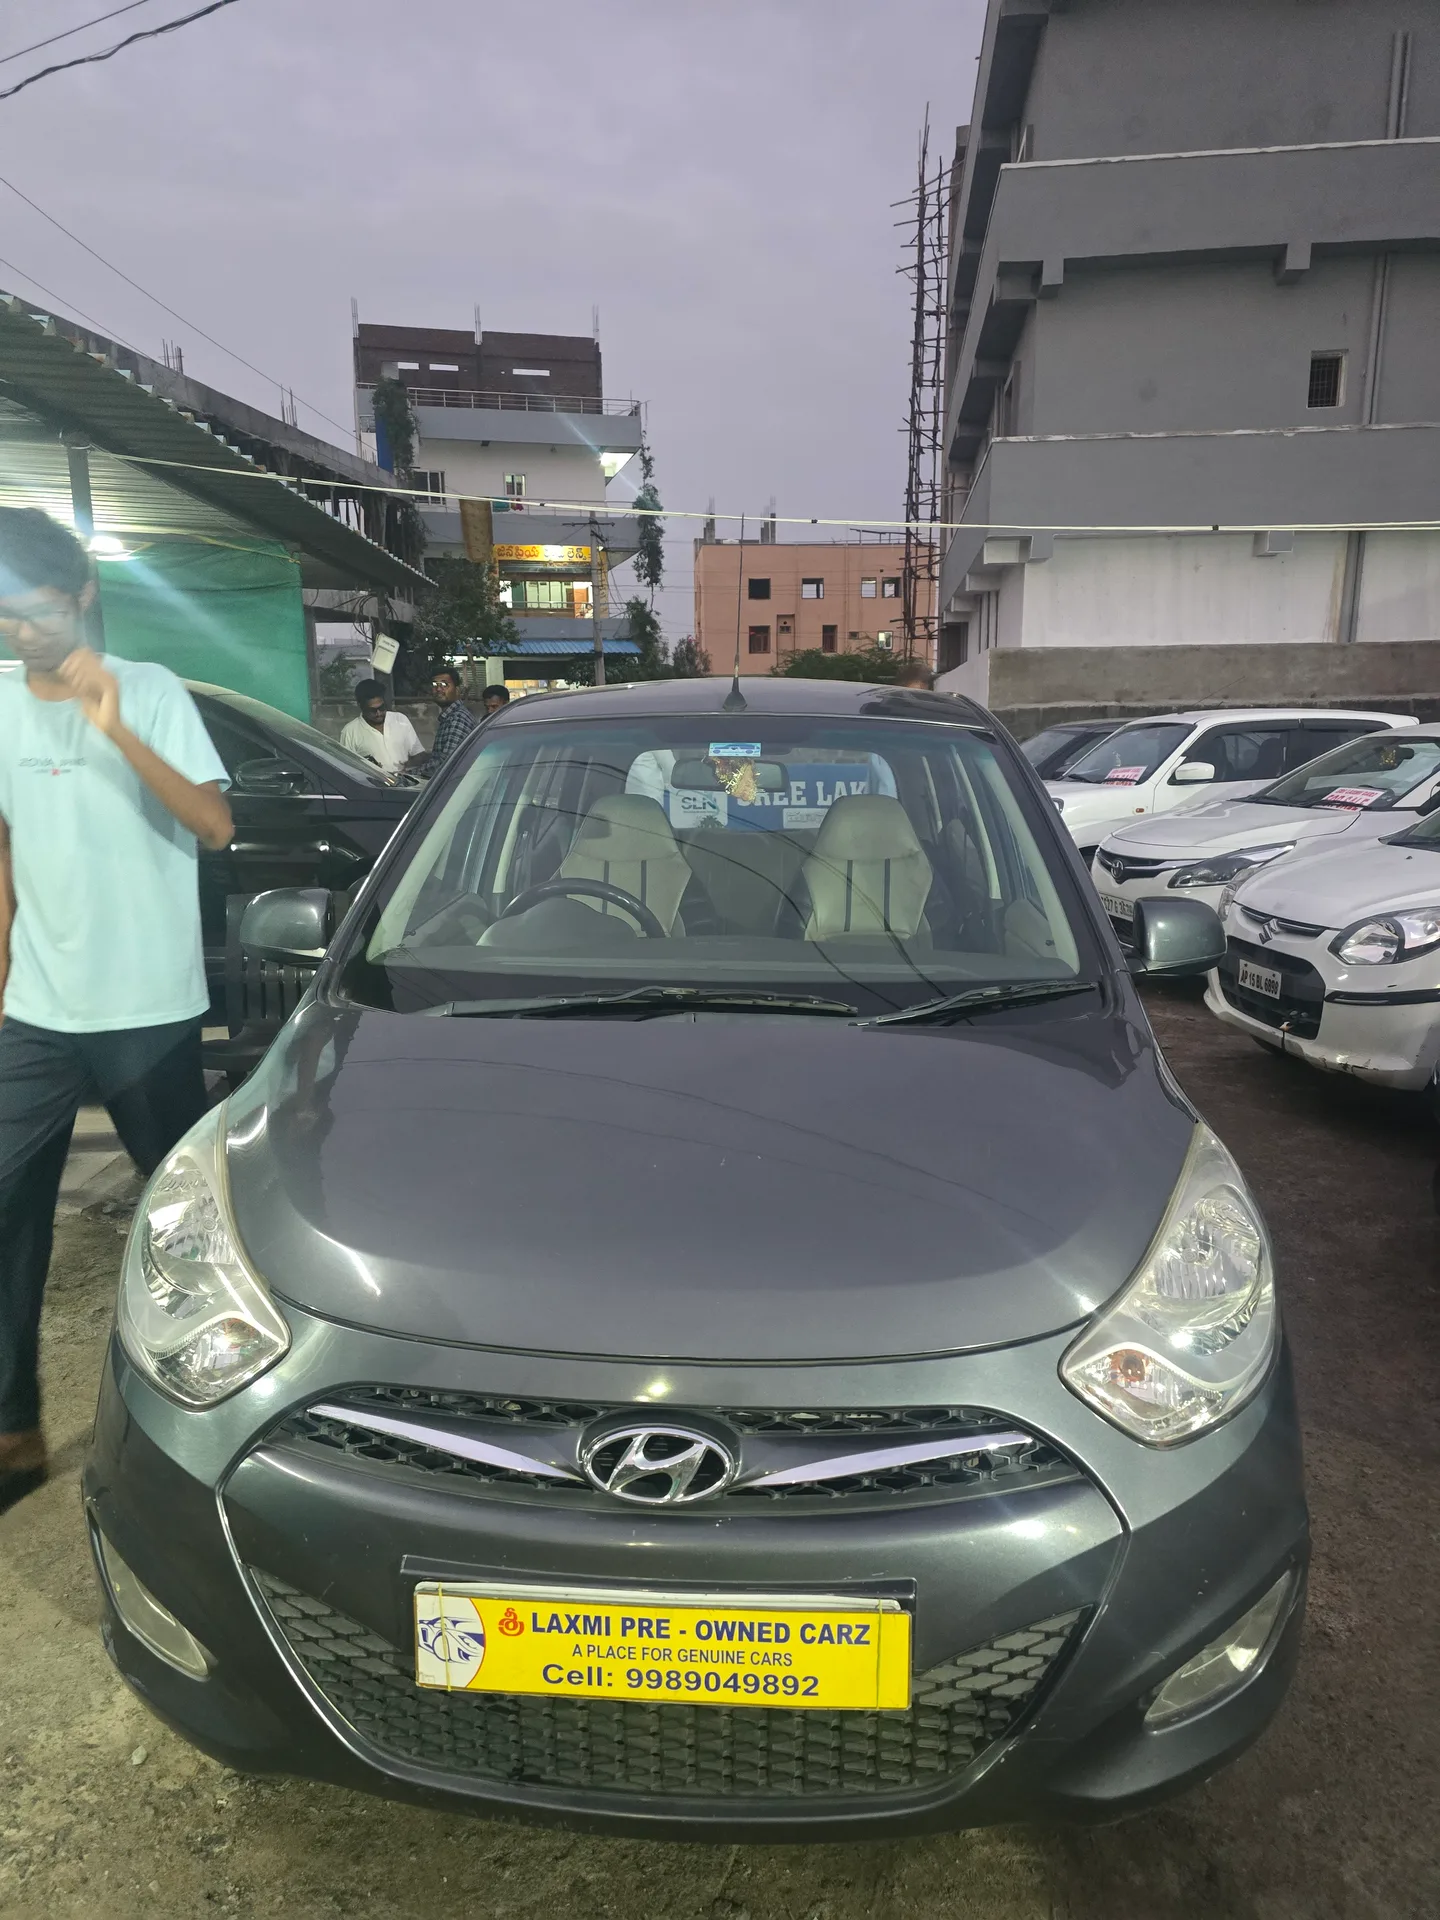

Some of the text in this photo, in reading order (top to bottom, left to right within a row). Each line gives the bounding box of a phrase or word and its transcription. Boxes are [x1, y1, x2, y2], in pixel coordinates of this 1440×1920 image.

[532, 1612, 610, 1636] LAXMI
[621, 1616, 670, 1639] PRE
[695, 1619, 790, 1643] OWNED
[800, 1623, 870, 1645] CARZ
[572, 1643, 793, 1666] A PLACE FOR GENUINE CARS
[543, 1664, 819, 1696] Cell: 9989049892
